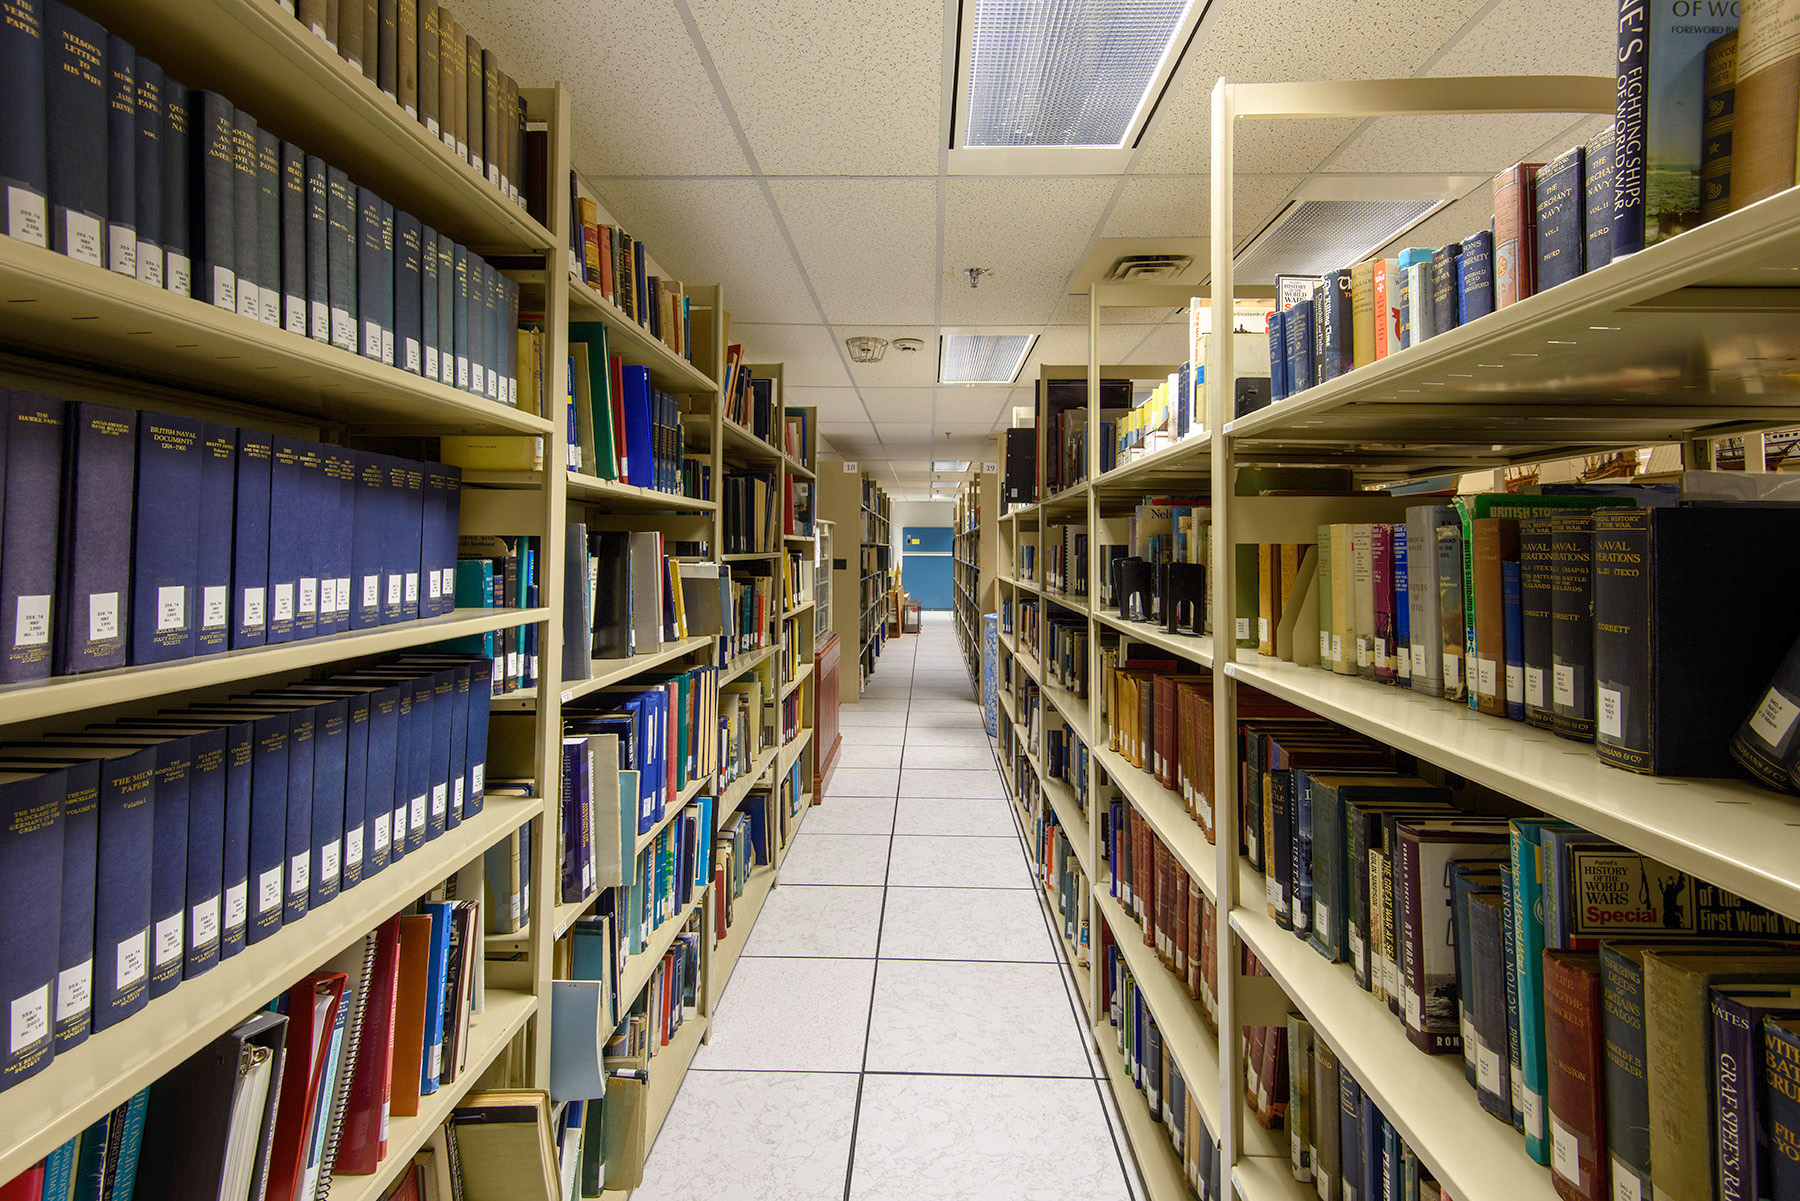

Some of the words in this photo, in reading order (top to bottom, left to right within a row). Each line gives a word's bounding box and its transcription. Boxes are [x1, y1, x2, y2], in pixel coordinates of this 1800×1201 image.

[1672, 0, 1702, 17] OF
[1671, 25, 1724, 35] FOREWORD
[62, 31, 102, 56] NELSON'S
[65, 43, 100, 66] LETTERS
[79, 60, 90, 70] TO
[64, 63, 79, 75] HIS
[84, 72, 102, 87] WIFE
[1617, 74, 1628, 99] OF
[1625, 66, 1642, 152] FIGHTING
[1615, 100, 1627, 168] WORLD
[1592, 156, 1607, 168] THE
[1546, 182, 1558, 195] THE
[1588, 178, 1612, 196] NAVY
[1625, 156, 1641, 208] SHIPS
[1614, 170, 1625, 212] WAR
[1541, 203, 1563, 221] NAVY
[1614, 213, 1624, 221] I
[1589, 227, 1609, 240] HURD
[1463, 240, 1482, 251] SONS
[1466, 249, 1474, 257] OF
[1543, 249, 1561, 261] HURD
[18, 415, 42, 423] HAWKE
[150, 426, 176, 436] BRITISH
[176, 430, 197, 438] NAVAL
[154, 434, 193, 445] DOCUMENTS
[986, 464, 996, 472] 19
[1490, 506, 1530, 518] BRITISH
[1522, 543, 1550, 552] NAVAL
[1598, 541, 1631, 551] NAVAL
[1562, 566, 1589, 574] (MAPS)
[1614, 568, 1640, 577] (TEXT)
[1523, 610, 1550, 618] CORBETT
[1598, 622, 1630, 634] CORBETT
[112, 777, 131, 787] THE
[121, 779, 150, 794] PAPERS
[14, 809, 28, 818] THE
[30, 801, 59, 813] MARITIME
[123, 799, 142, 809] Volume
[9, 819, 43, 831] GERMANY
[15, 812, 49, 823] BLOCKADE
[19, 825, 41, 834] GREAT
[42, 819, 55, 829] WAR
[1512, 832, 1521, 886] Warships
[1383, 859, 1391, 877] THE
[1584, 866, 1628, 875] HISTORY
[1384, 878, 1392, 905] GREAT
[1513, 888, 1523, 902] of
[1585, 882, 1629, 892] WORLD
[1585, 892, 1629, 905] WARS
[1700, 888, 1714, 906] of
[1385, 907, 1393, 929] WAR
[1515, 902, 1525, 941] World
[1586, 906, 1658, 924] Special
[1700, 909, 1732, 931] First
[1736, 910, 1779, 934] World
[1386, 929, 1393, 942] AT
[1404, 921, 1412, 938] AT
[1386, 943, 1394, 961] SEA
[1405, 940, 1413, 963] WAR
[1516, 941, 1526, 967] War
[1406, 964, 1414, 982] AT
[1604, 957, 1641, 984] STIRRING
[1555, 972, 1575, 991] LIFE
[1608, 970, 1637, 994] DEEDS
[1616, 986, 1625, 997] OF
[1568, 994, 1583, 1011] THE
[1710, 1001, 1750, 1030] YATES
[1606, 1040, 1629, 1062] HAROLD
[4, 1059, 23, 1074] NAVY
[14, 1057, 41, 1074] SOCIETY
[1606, 1049, 1643, 1079] WHEELER
[1720, 1053, 1738, 1109] GRAF
[1722, 1107, 1740, 1171] SPEE'S
[57, 1139, 73, 1201] CONSERVATIO
